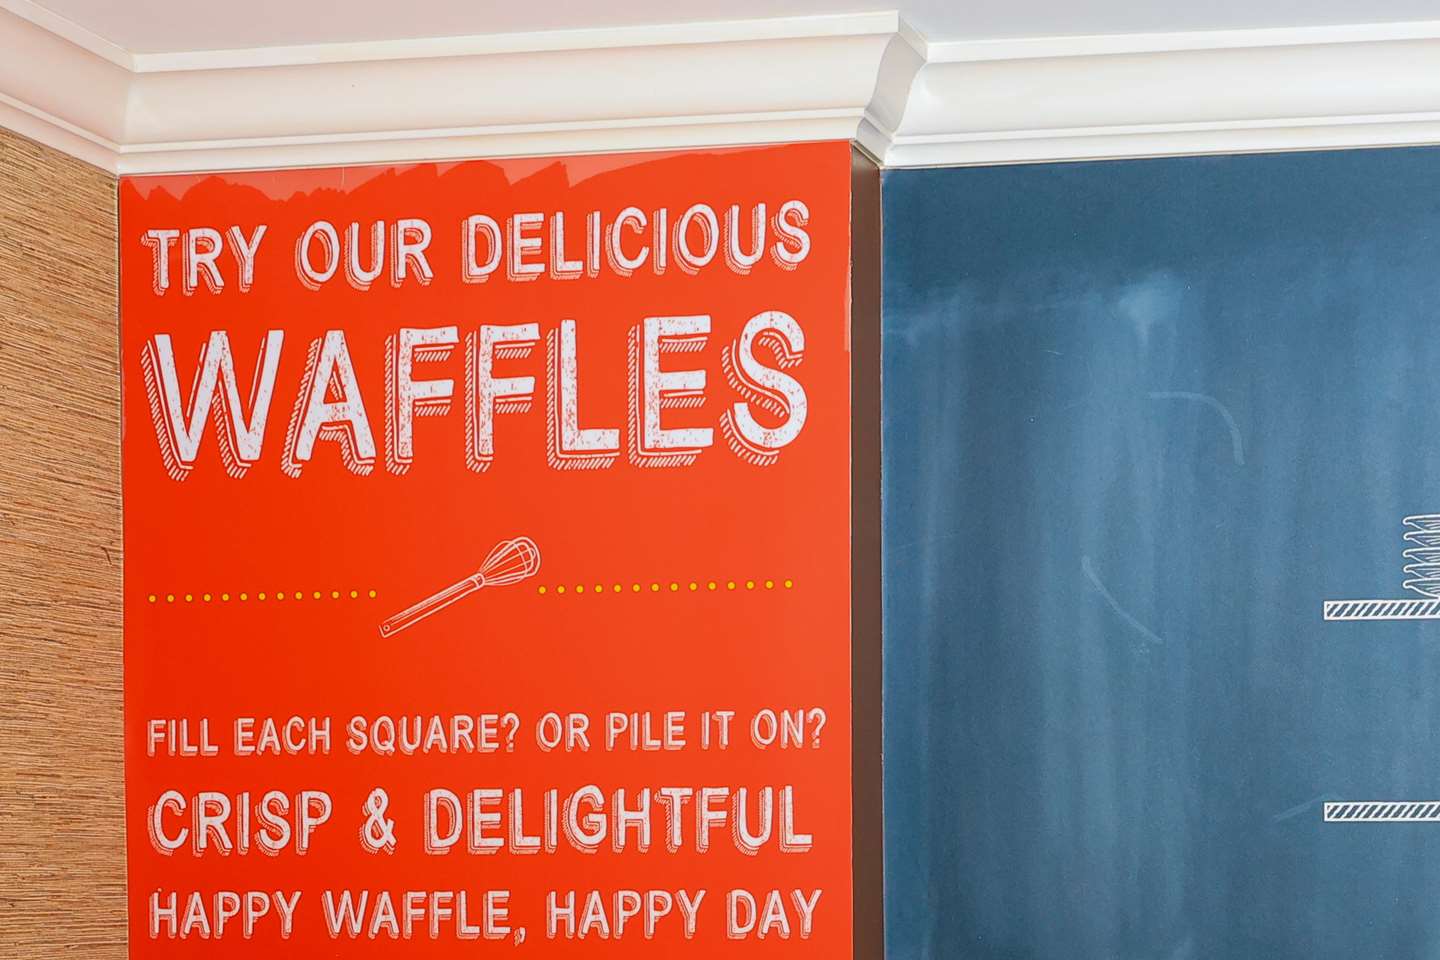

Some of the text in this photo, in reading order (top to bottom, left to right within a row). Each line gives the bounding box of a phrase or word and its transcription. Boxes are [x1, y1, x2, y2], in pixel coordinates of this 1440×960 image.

[141, 200, 811, 296] TRY OUR DELICIOUS
[140, 310, 808, 482] WAFFLES
[147, 707, 827, 756] FILL EACH SQUARE? OR PILE IT ON?
[148, 784, 813, 856] CRISP & DELIGHTFUL
[148, 889, 822, 945] HAPPY WAFFLE, HAPPY DAY
